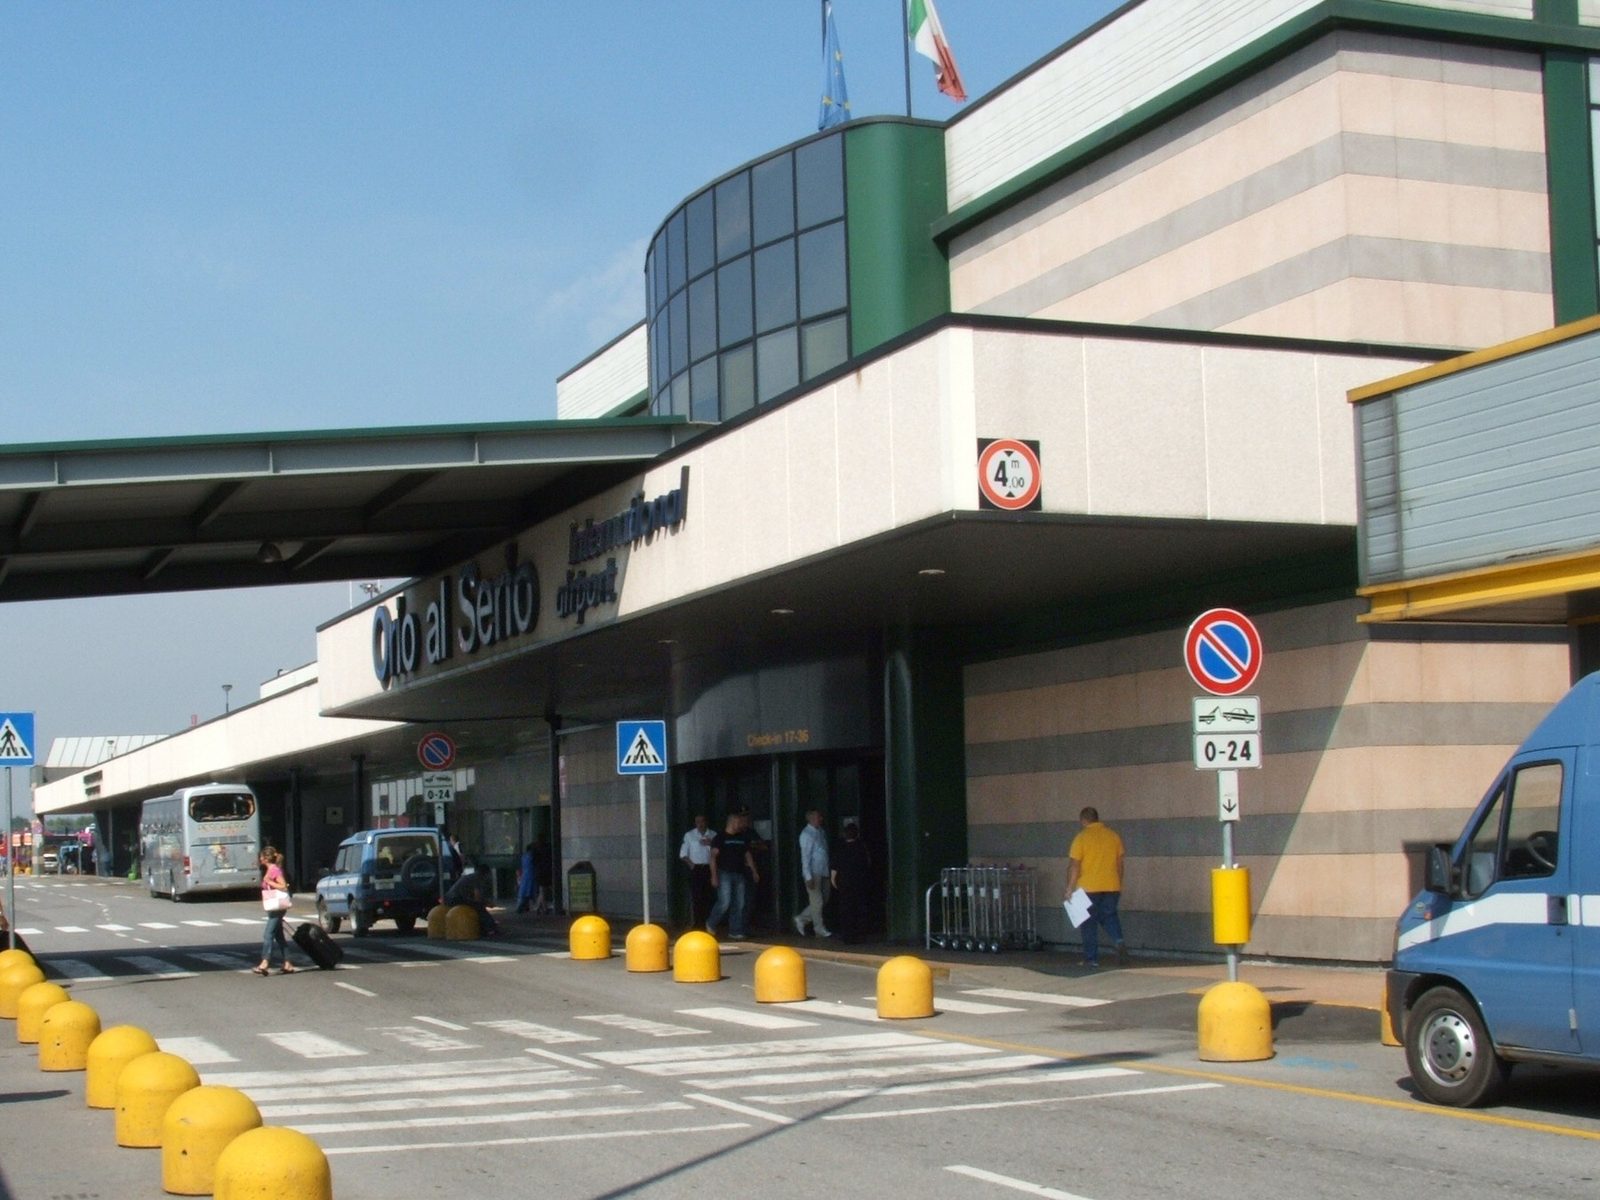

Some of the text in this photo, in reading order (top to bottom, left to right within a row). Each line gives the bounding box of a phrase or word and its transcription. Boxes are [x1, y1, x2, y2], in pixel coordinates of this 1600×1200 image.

[994, 460, 1008, 487] 4
[425, 576, 453, 665] al
[1204, 740, 1252, 762] 0-24
[427, 789, 451, 800] 0-24
